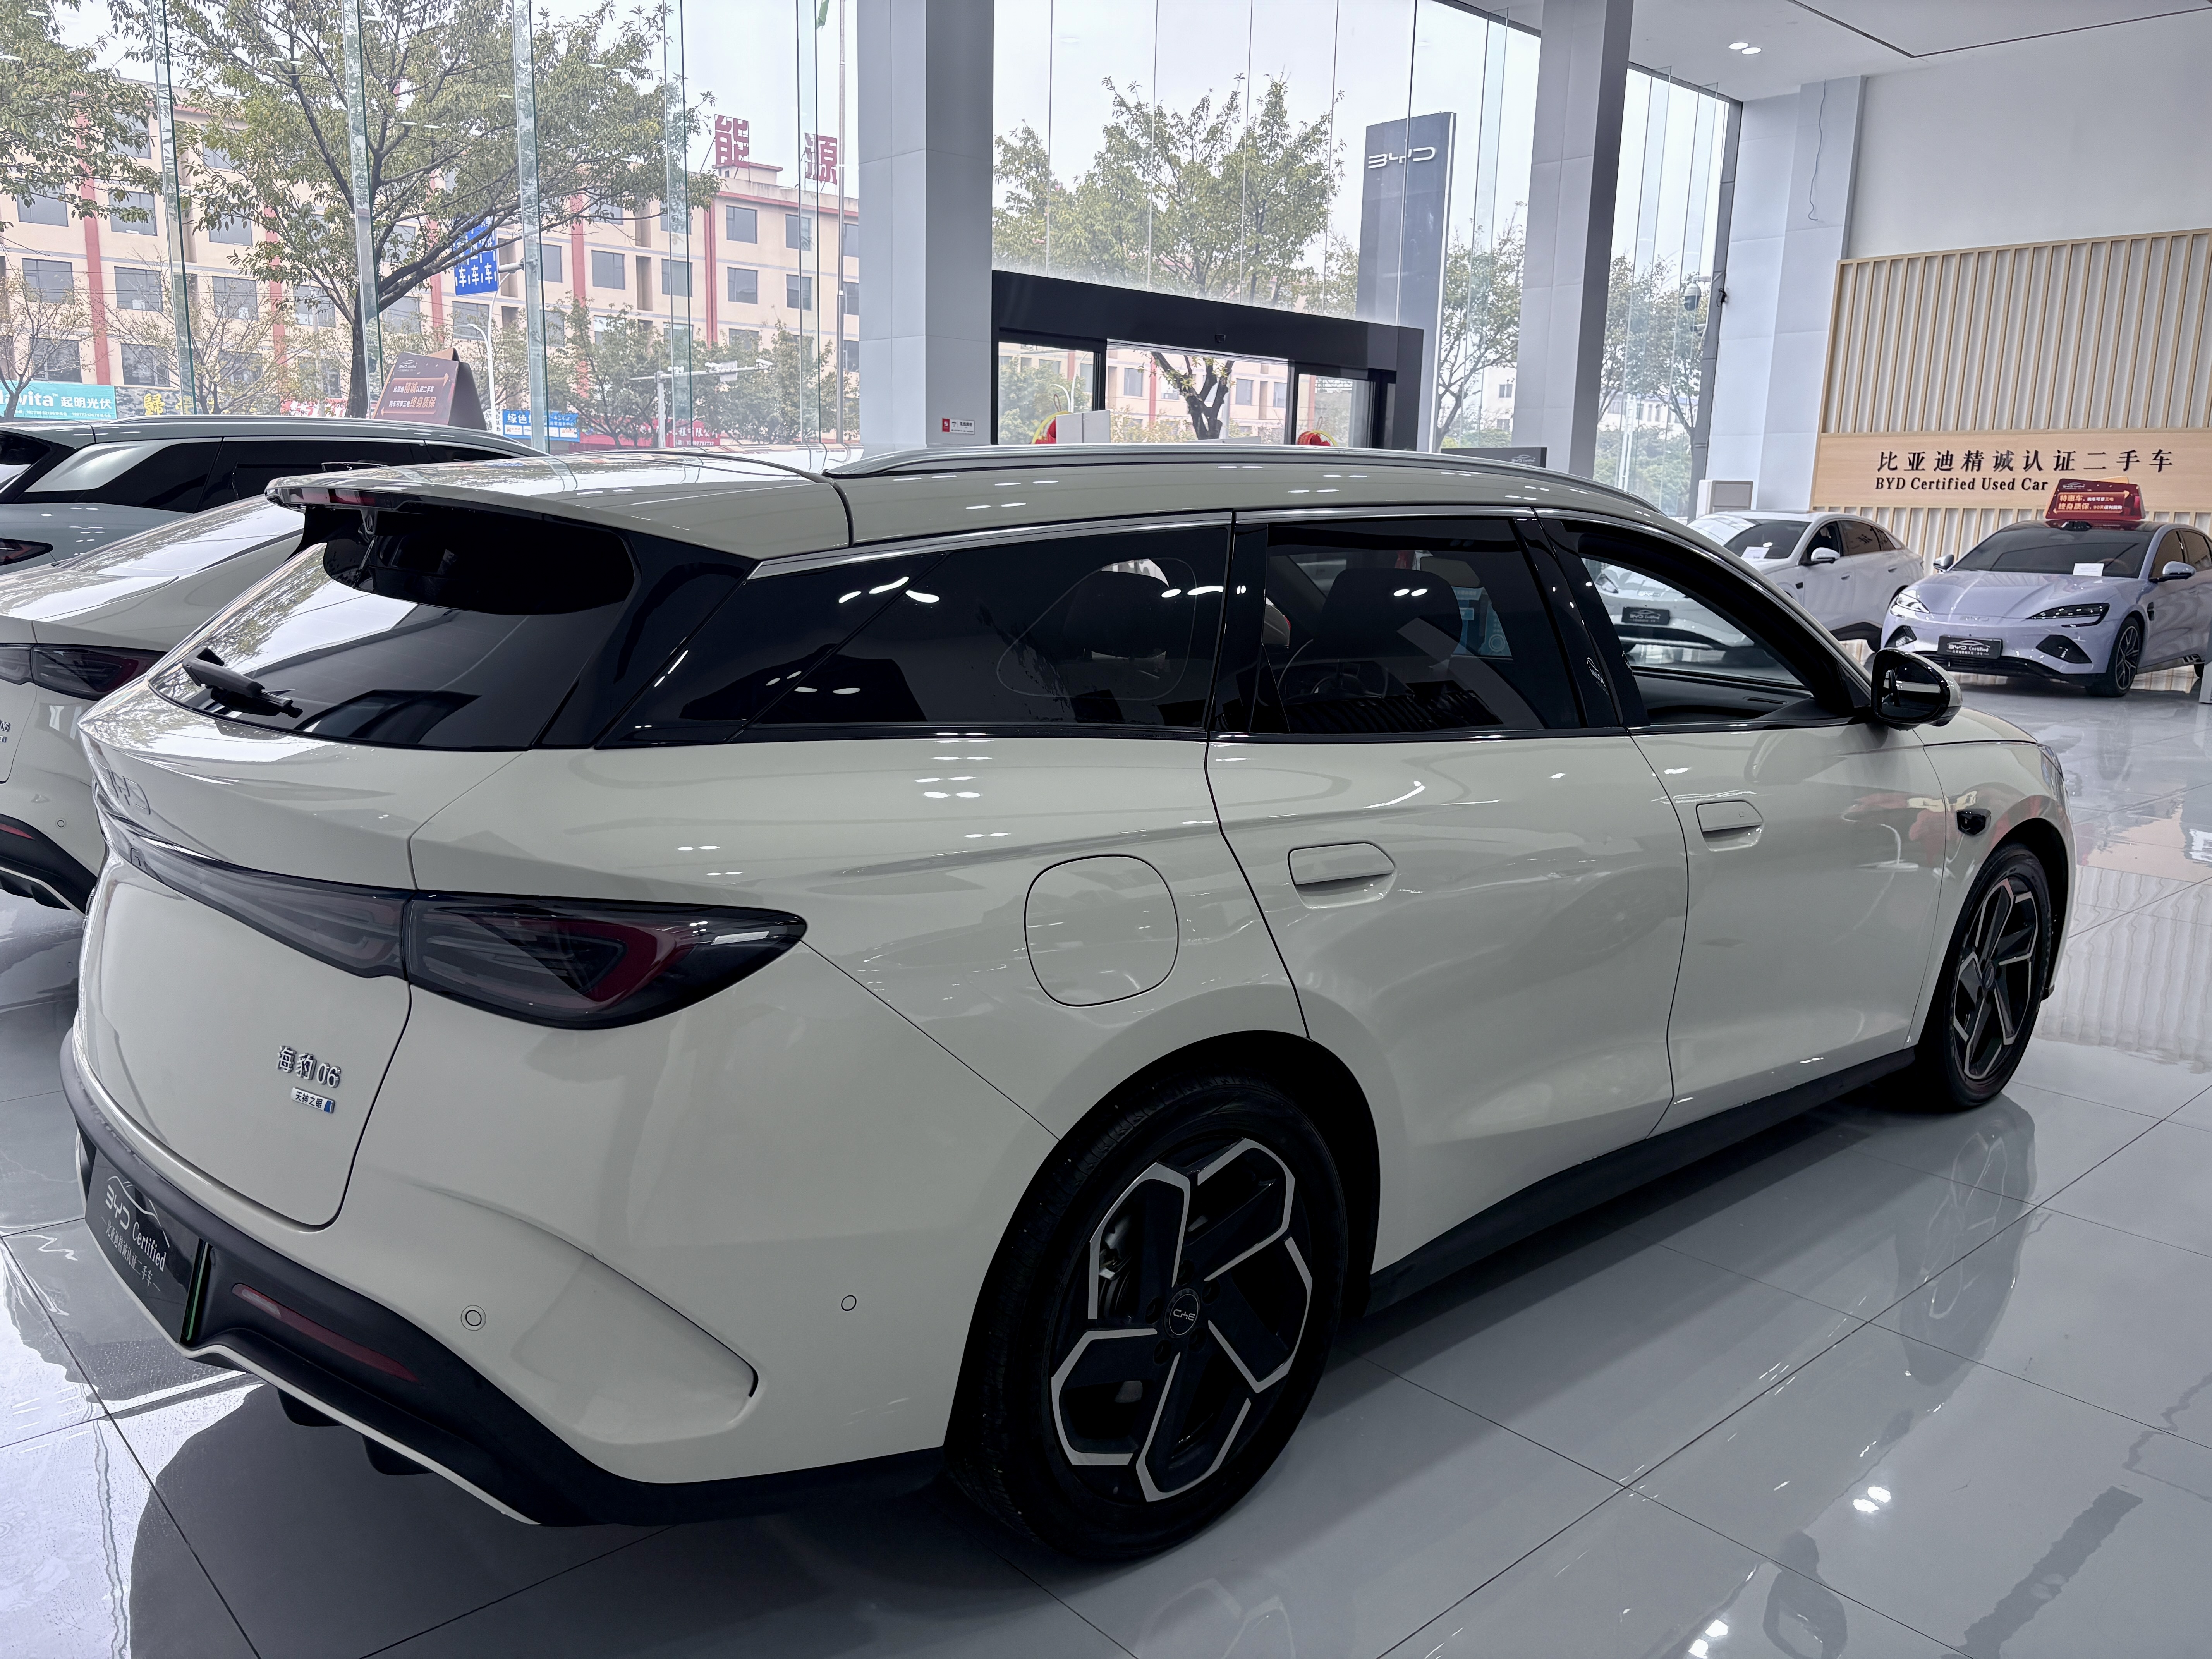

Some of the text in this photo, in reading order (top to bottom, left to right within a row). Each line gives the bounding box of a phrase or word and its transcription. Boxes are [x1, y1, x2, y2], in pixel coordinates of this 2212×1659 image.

[1368, 146, 1436, 169] BYD
[61, 396, 112, 410] 起明光伏
[1876, 449, 2173, 473] 比亚迪精诚认证二手车
[1875, 477, 2048, 491] BYD Certified Used Car
[295, 1091, 323, 1108] 天神之眼
[105, 1184, 167, 1272] BYD Certified
[106, 1220, 153, 1287] 比亚迪精诚认证二手车
